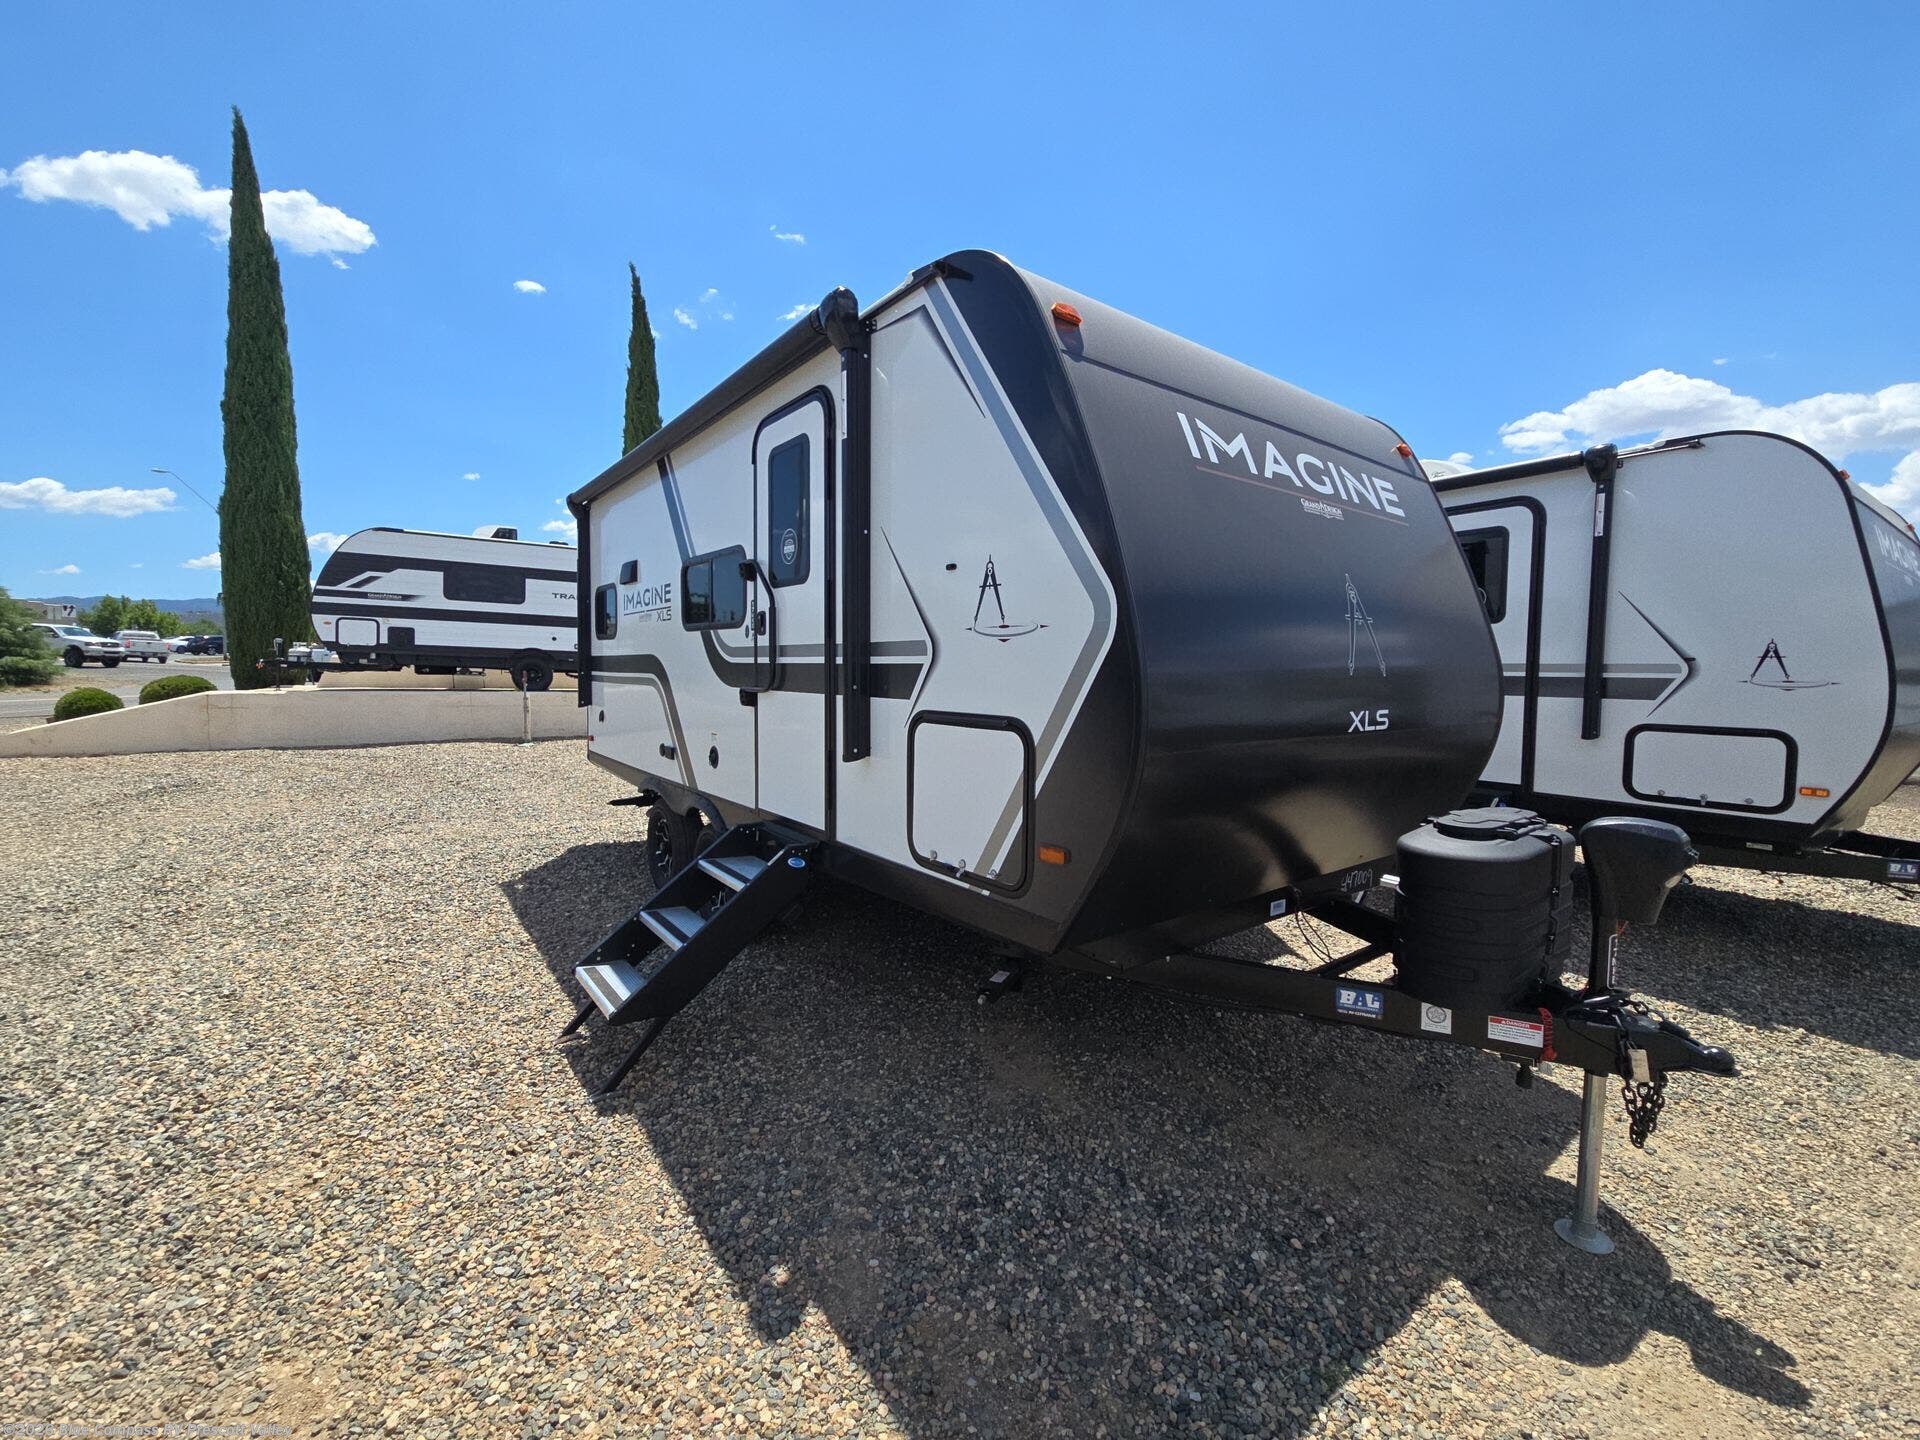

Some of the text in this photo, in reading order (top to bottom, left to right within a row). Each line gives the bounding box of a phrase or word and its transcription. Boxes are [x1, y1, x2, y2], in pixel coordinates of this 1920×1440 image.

[1177, 412, 1405, 517] IMAGINE
[551, 592, 576, 600] TRA
[623, 582, 671, 611] IMAGINE
[656, 609, 672, 622] XLS
[1348, 709, 1389, 732] XLS
[1506, 1020, 1530, 1029] DANGER
